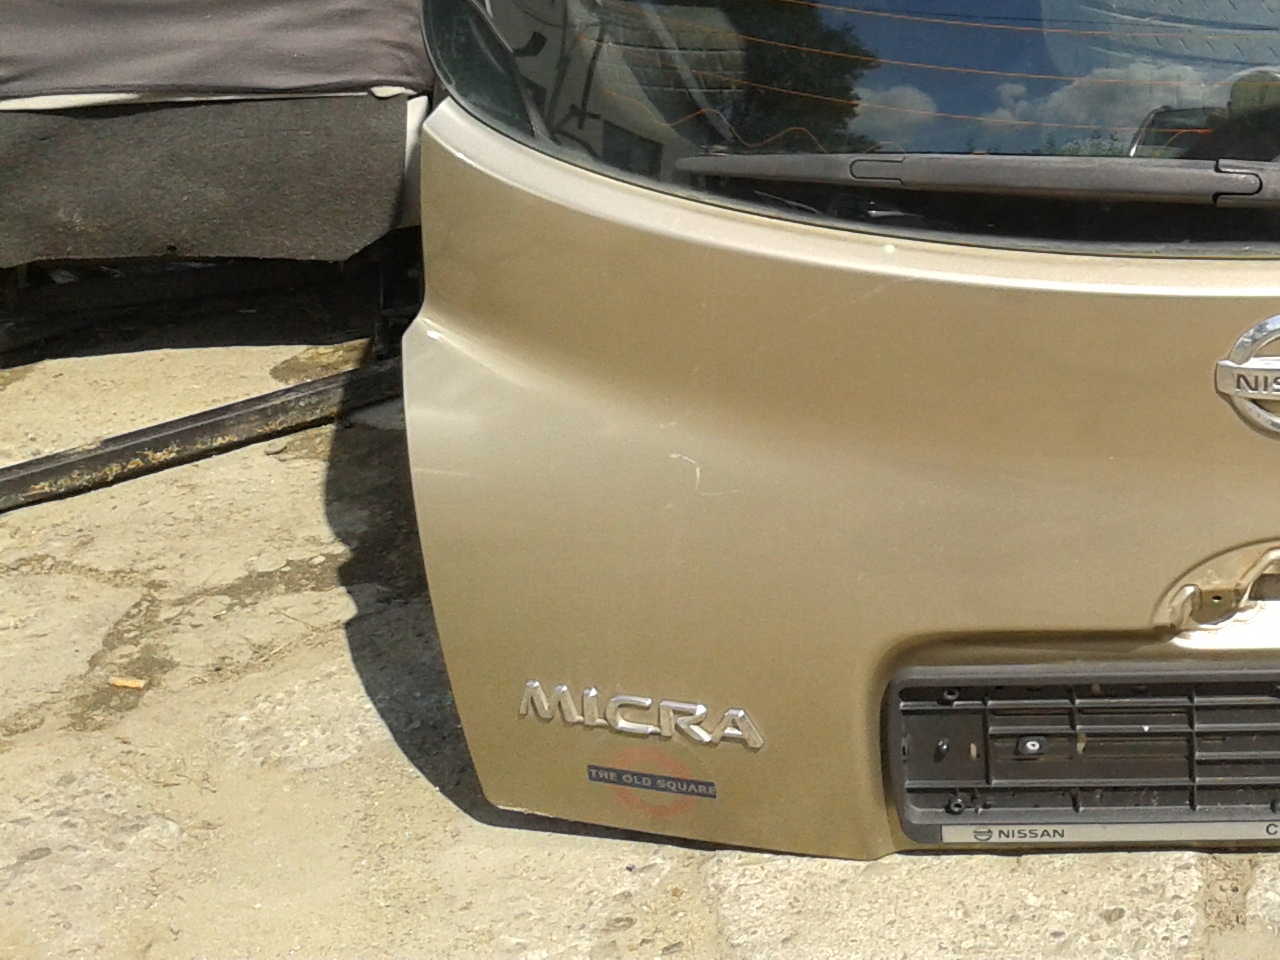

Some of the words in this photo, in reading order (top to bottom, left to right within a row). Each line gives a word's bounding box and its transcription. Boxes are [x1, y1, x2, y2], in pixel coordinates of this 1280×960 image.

[517, 679, 764, 750] MICRA
[589, 768, 617, 784] THE
[622, 773, 652, 788] OLD
[656, 778, 717, 796] SQUARE
[998, 829, 1065, 839] NISSAN
